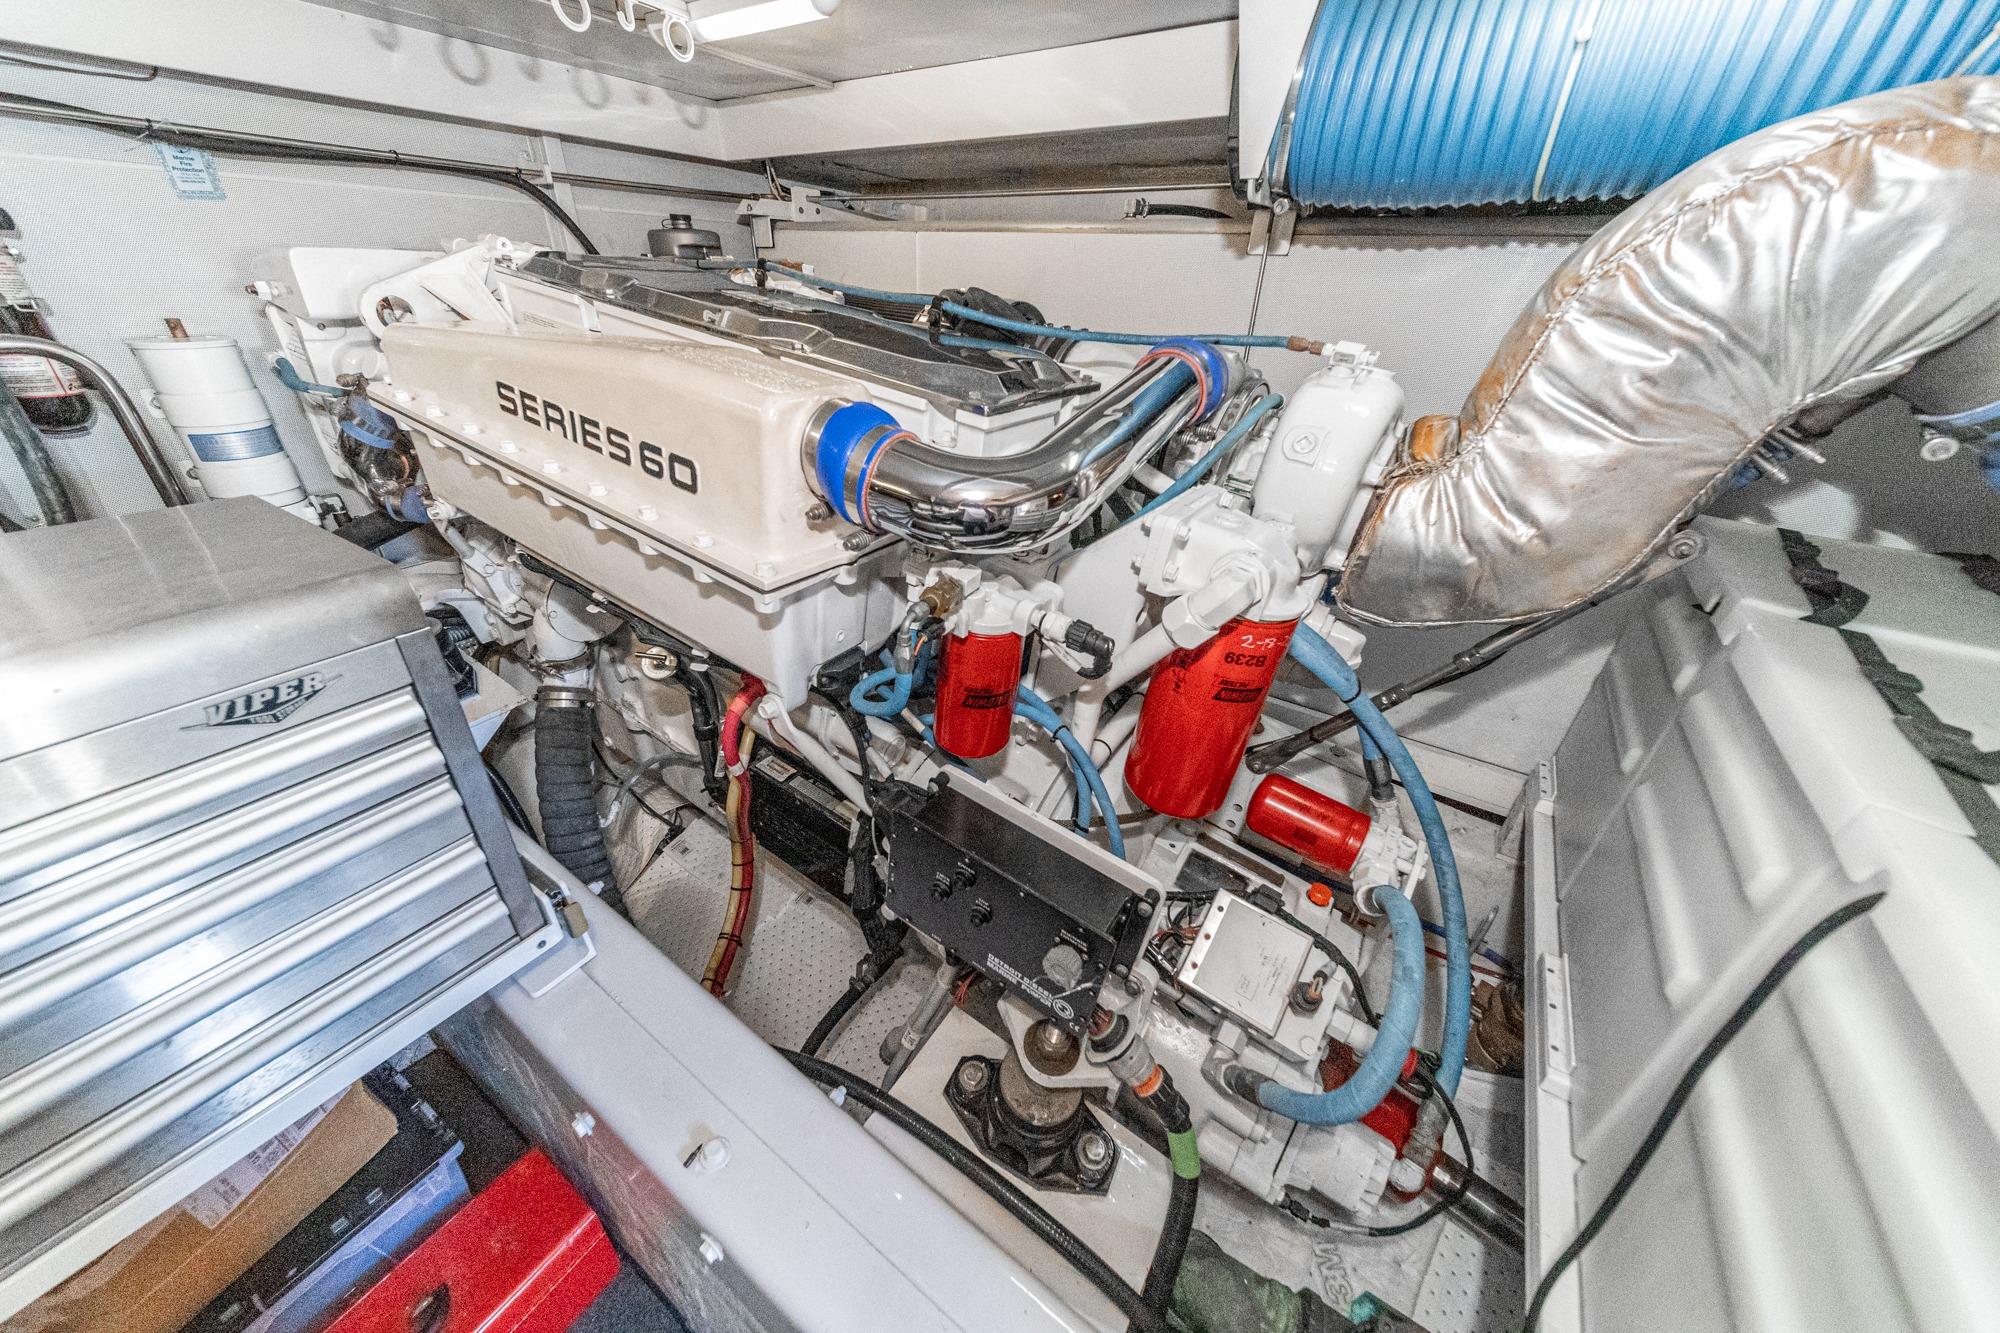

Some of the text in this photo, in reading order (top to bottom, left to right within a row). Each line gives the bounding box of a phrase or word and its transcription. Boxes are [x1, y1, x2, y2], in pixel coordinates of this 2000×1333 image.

[496, 381, 699, 495] SERIES 60
[1224, 651, 1268, 668] B239
[203, 671, 327, 727] VIPER
[986, 960, 1018, 985] MARINE
[987, 952, 1023, 979] DETROIT
